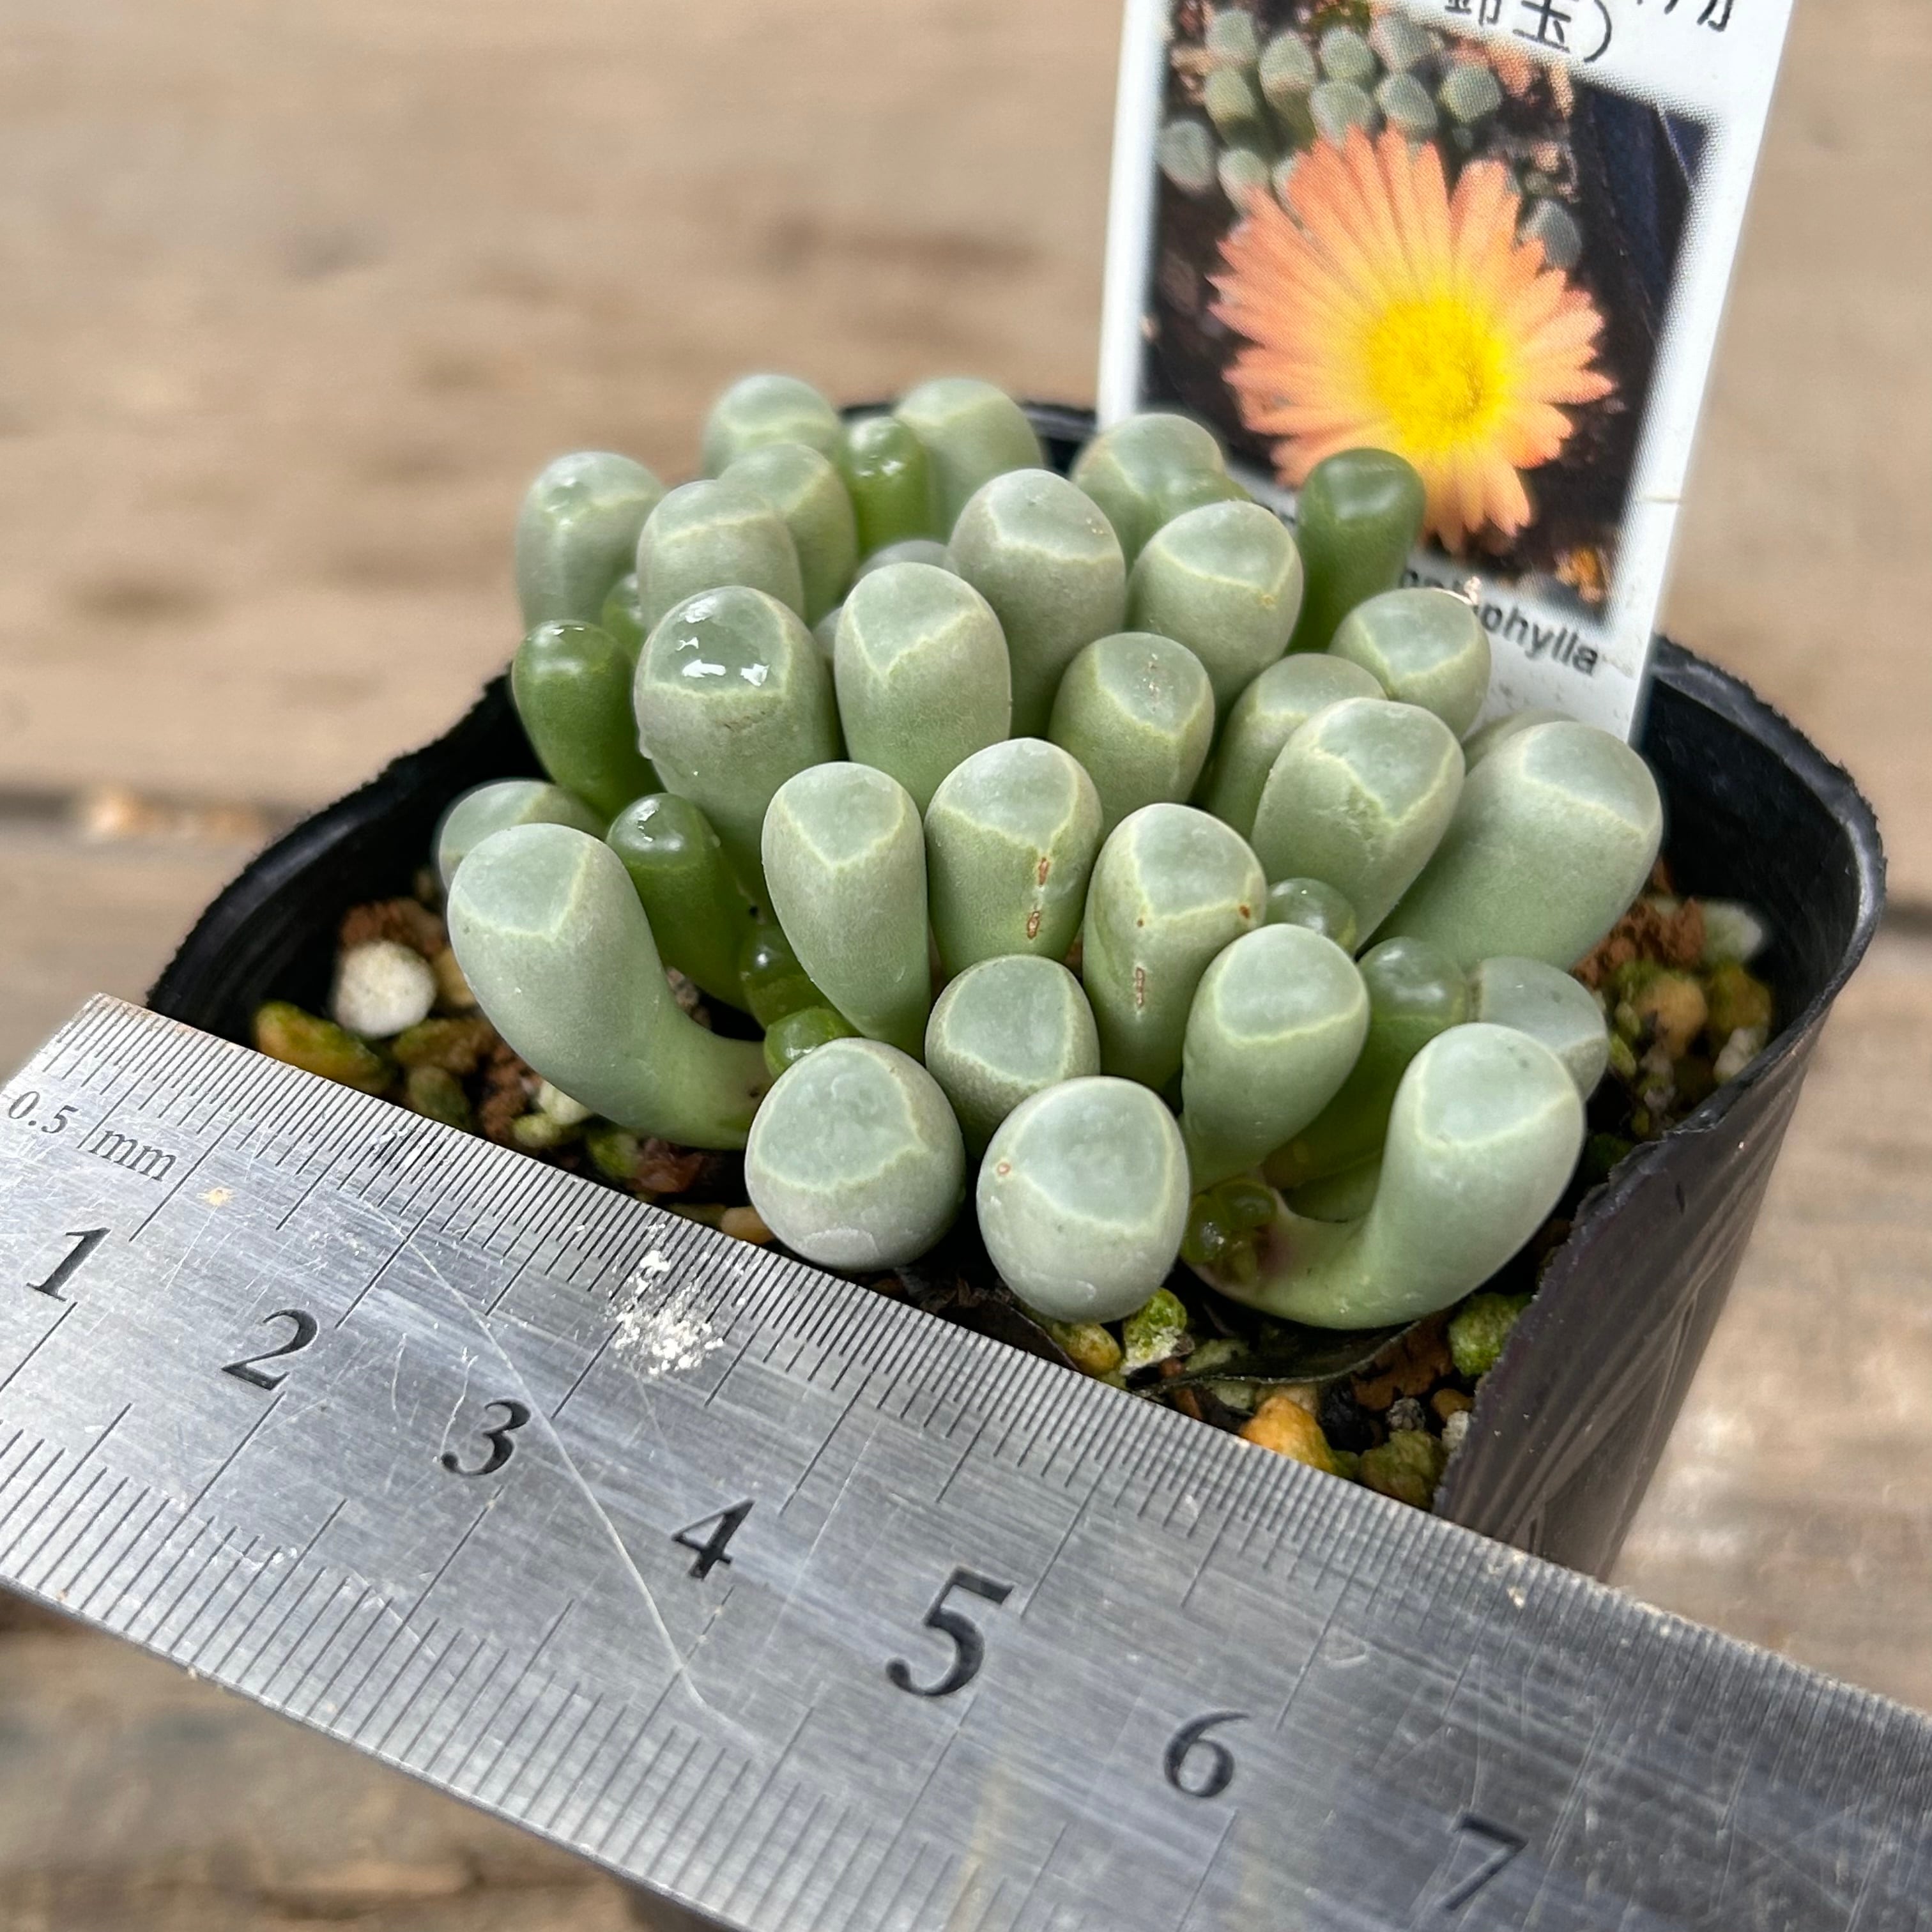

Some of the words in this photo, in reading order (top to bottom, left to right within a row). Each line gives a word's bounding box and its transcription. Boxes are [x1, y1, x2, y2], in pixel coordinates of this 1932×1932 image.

[8, 1090, 79, 1135] 0.5
[90, 1127, 177, 1182] mm
[26, 1227, 111, 1302] 1
[222, 1309, 319, 1390] 2
[440, 1399, 532, 1476] 3
[671, 1499, 755, 1580] 4
[885, 1565, 1015, 1698] 5
[1163, 1710, 1250, 1798] 6
[1444, 1812, 1528, 1912] 7
